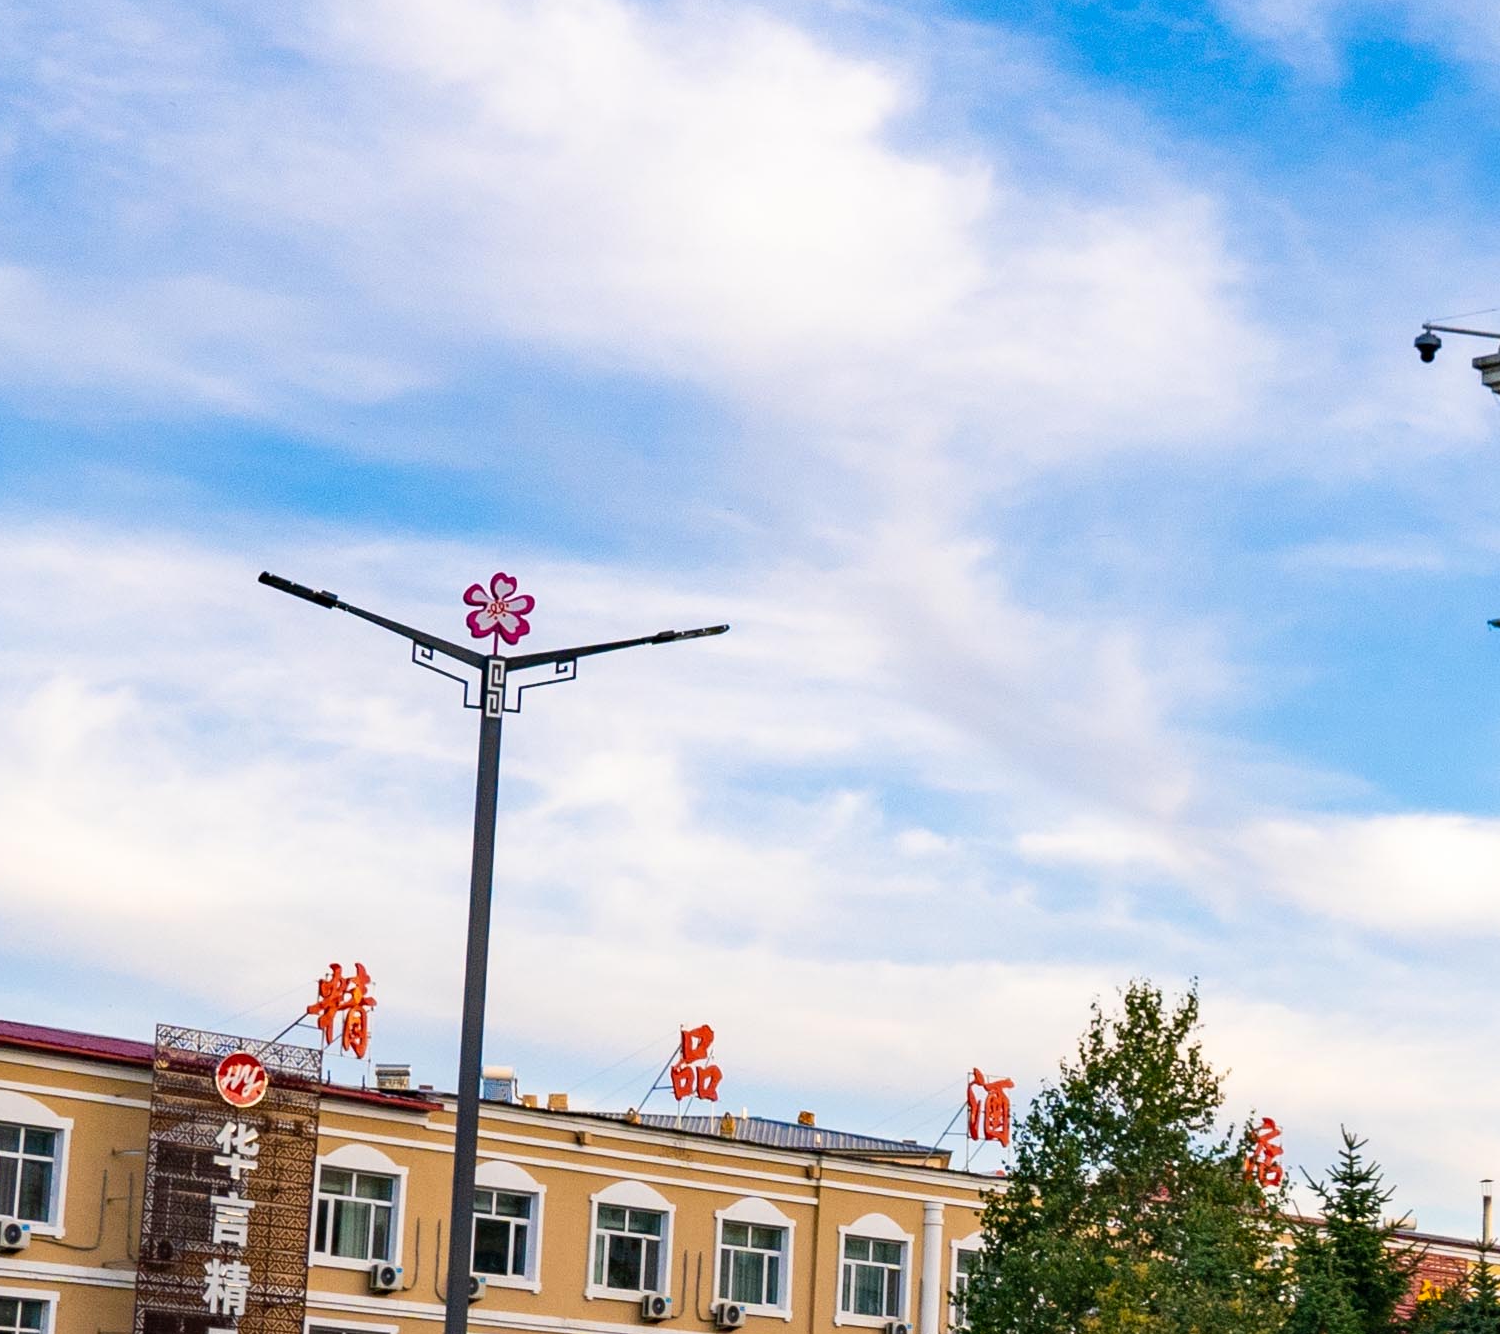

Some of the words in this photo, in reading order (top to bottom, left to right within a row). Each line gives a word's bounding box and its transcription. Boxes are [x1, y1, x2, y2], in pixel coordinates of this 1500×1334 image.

[307, 962, 378, 1059] 精
[671, 1023, 724, 1102] 品
[967, 1067, 1015, 1148] 酒
